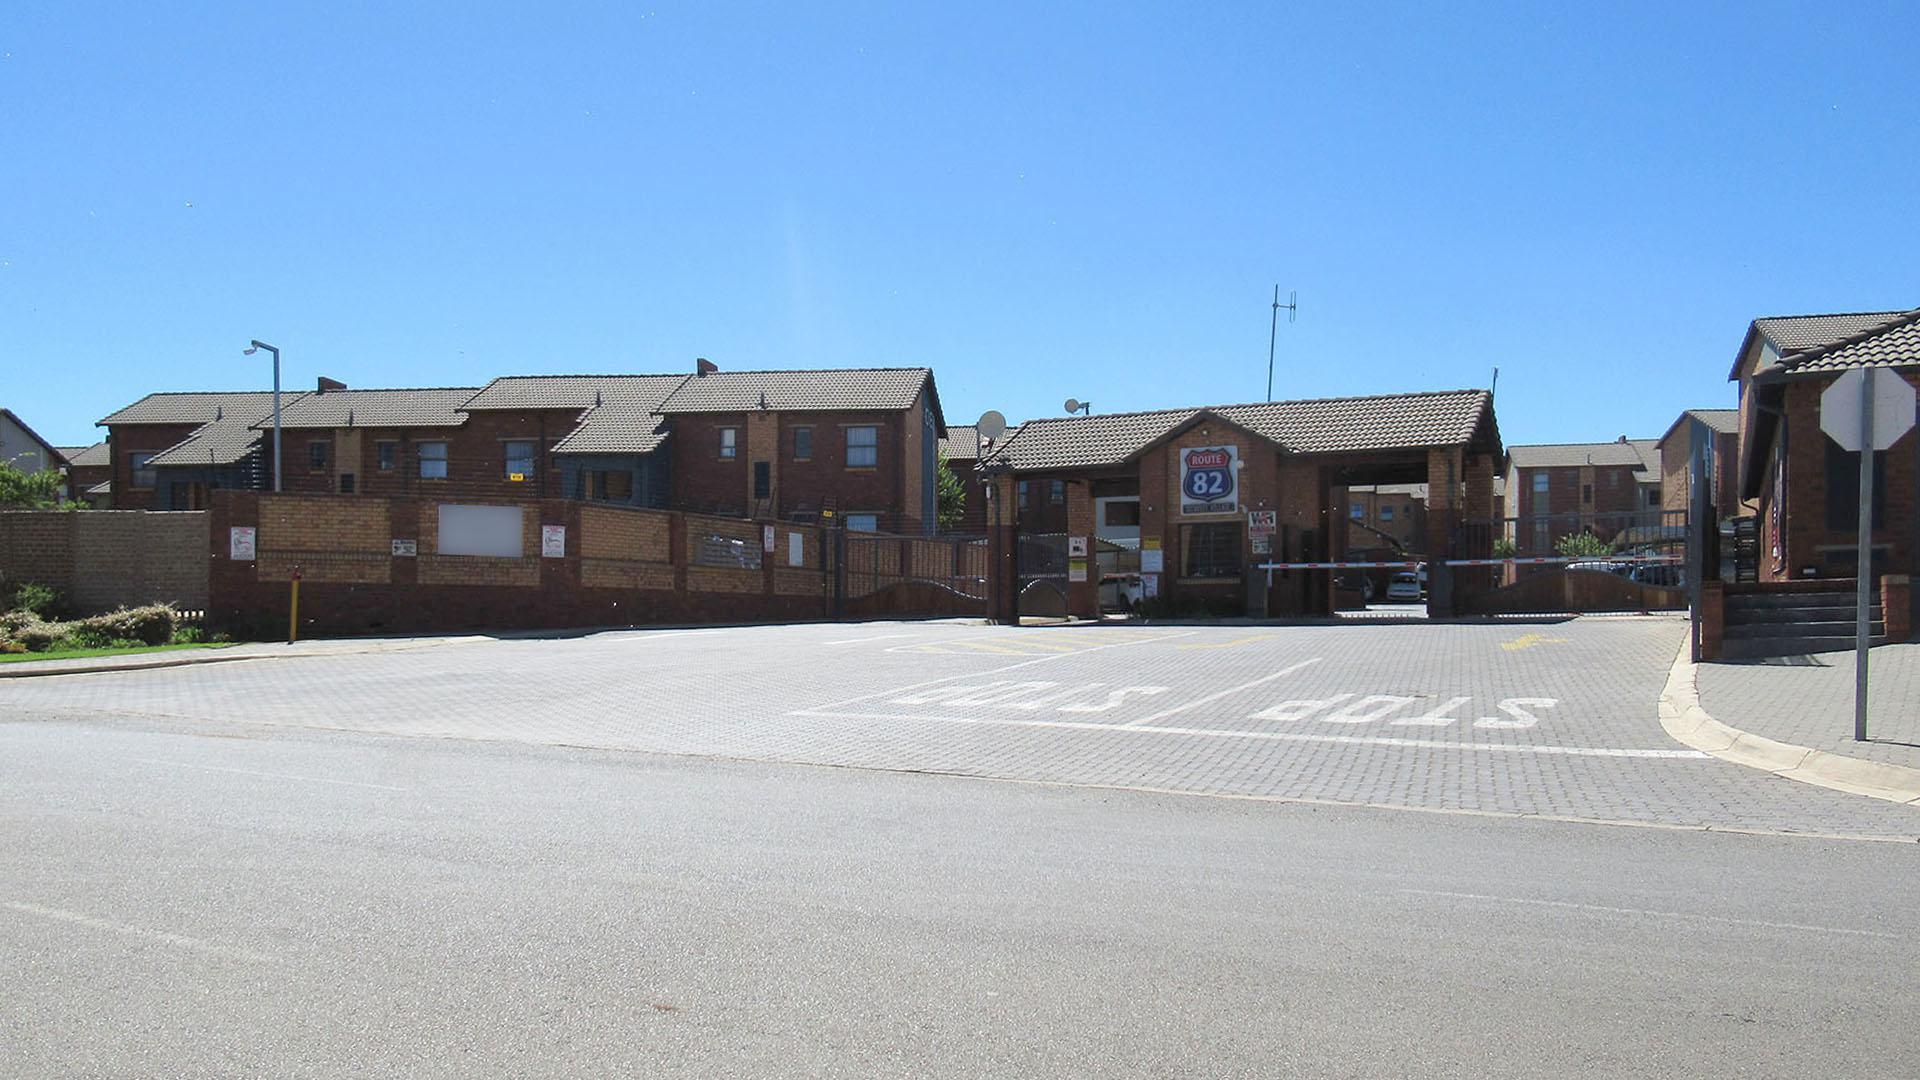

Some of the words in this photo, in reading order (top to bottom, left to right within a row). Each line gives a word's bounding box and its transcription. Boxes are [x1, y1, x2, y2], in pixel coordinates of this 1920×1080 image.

[1192, 454, 1223, 465] ROUTE
[1192, 471, 1223, 494] 82
[1247, 693, 1559, 729] STOP
